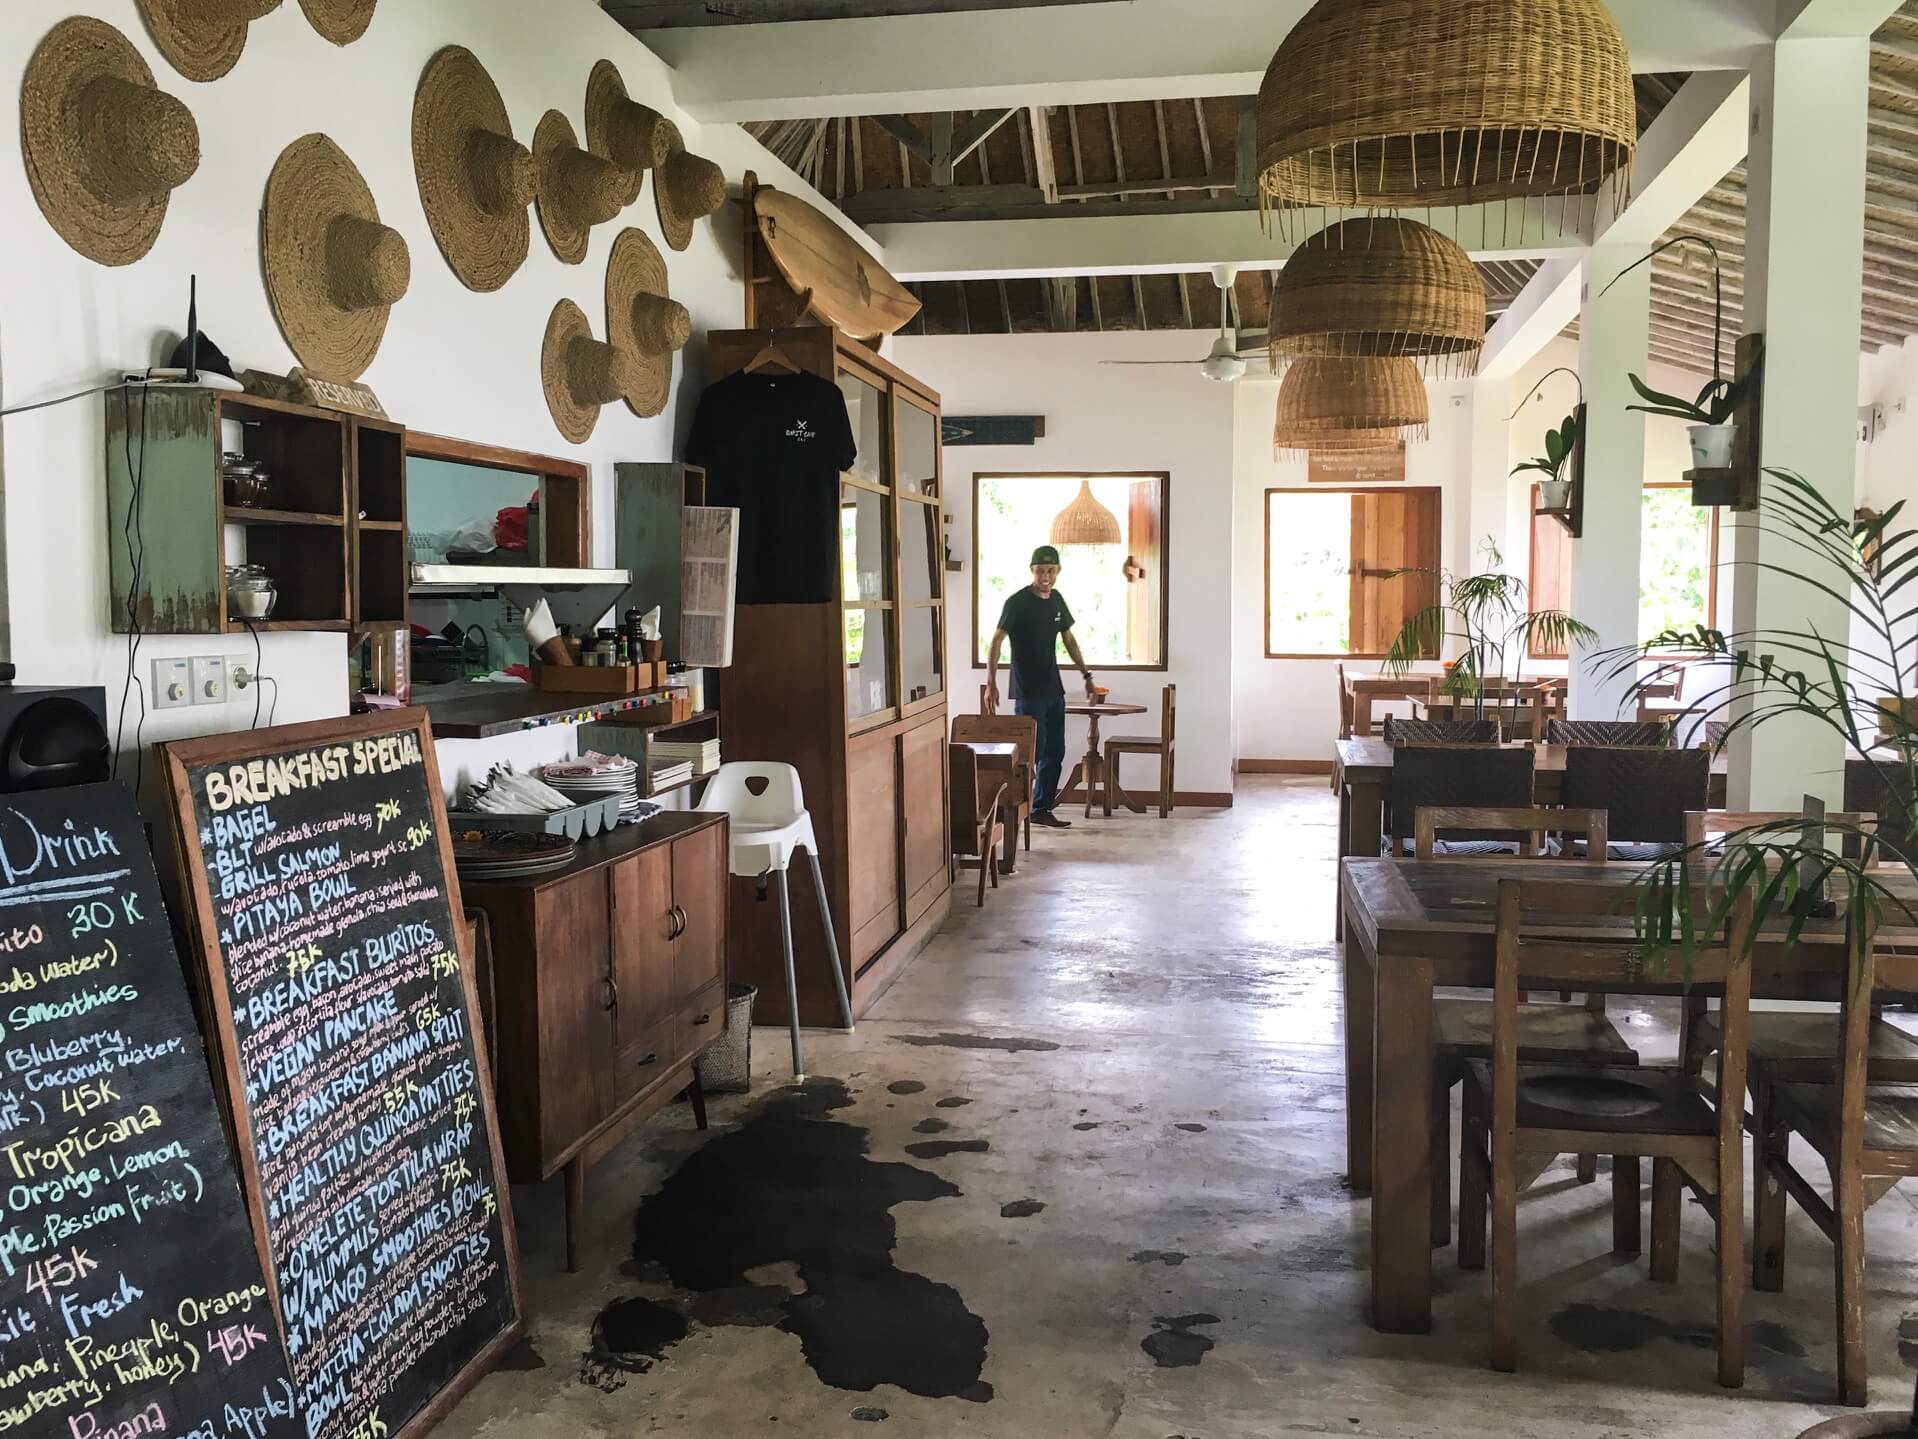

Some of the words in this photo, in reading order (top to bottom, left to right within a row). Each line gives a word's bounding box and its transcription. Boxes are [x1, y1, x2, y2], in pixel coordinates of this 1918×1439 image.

[306, 377, 382, 412] RESERVED
[206, 748, 348, 810] BREAKFAST
[0, 806, 120, 885] Drink
[213, 805, 276, 848] BAGEL
[215, 841, 253, 877] BLT
[278, 842, 342, 882] SALMON
[67, 901, 115, 939] 30
[121, 892, 144, 925] K
[309, 873, 358, 912] BOWL
[249, 949, 363, 1028] BREAKFAST
[256, 1032, 321, 1091] VEGAN
[324, 991, 397, 1048] PANCAKE
[61, 1078, 120, 1117] 45K
[265, 1063, 372, 1153] BREAKFAST
[371, 1026, 430, 1078] BANANA
[3, 1104, 162, 1179] Tropicana
[279, 1136, 358, 1211] HEALTHY
[287, 1196, 366, 1278] OMELETE
[433, 1119, 473, 1164] WRAP
[26, 1246, 98, 1305] 45K
[301, 1263, 369, 1343] MANGO
[452, 1168, 492, 1218] BOWL
[60, 1271, 144, 1338] Fresh
[178, 1284, 266, 1327] Orange
[208, 1324, 267, 1366] 45K
